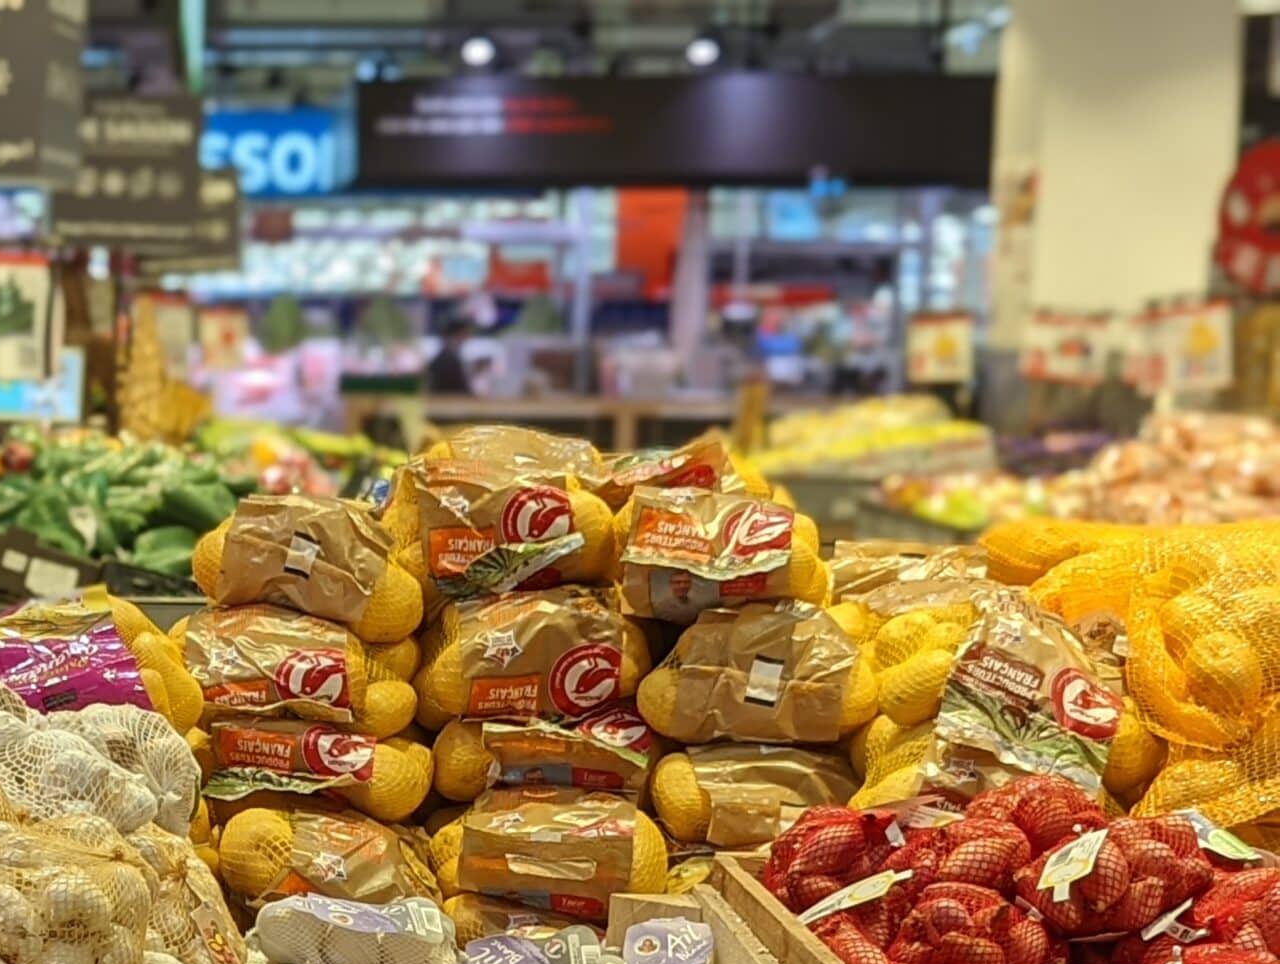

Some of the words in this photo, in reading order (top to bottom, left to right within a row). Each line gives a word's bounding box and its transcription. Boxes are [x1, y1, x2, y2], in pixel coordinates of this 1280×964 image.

[968, 663, 1038, 700] PRODUCTEURS
[981, 655, 1041, 687] FRANÇAIS
[230, 752, 290, 768] PRODUCTEURS
[237, 738, 292, 757] FRANÇAIS
[666, 924, 701, 958] Ail
